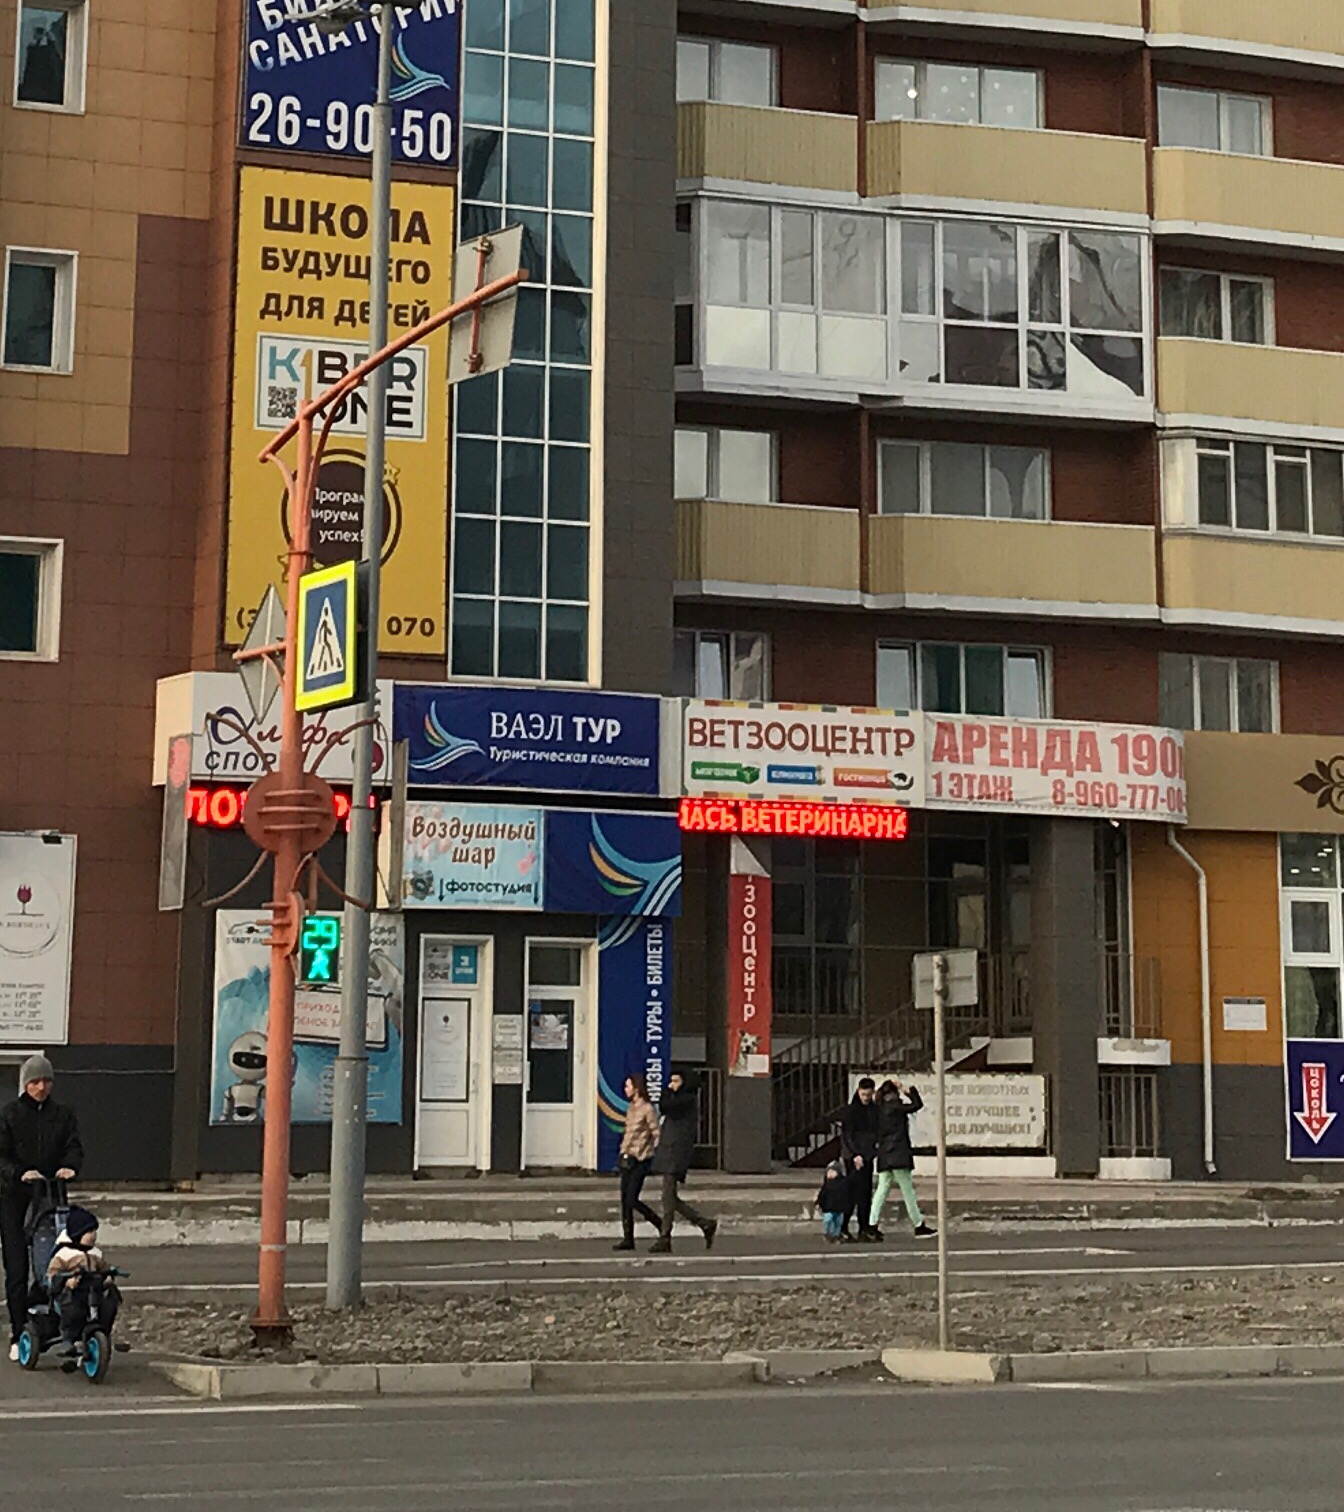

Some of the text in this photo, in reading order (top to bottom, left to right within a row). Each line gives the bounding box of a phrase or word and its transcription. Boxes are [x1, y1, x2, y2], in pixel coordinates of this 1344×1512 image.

[261, 246, 431, 286] БУДУЩГО
[259, 292, 431, 329] ДЛЯ ДЕЕЙ
[387, 616, 435, 638] 070
[490, 711, 622, 744] ВАЭЛ ТУР
[688, 717, 916, 757] ВЕТЗООЦЕНТР
[205, 750, 278, 772] СПОР
[489, 746, 650, 768] Туристическая компания
[932, 720, 1185, 781] АРЕНДА 190
[931, 771, 943, 798] 1
[948, 772, 1014, 803] ЭТАЖ
[412, 814, 536, 845] Воздушный
[452, 845, 496, 870] шар
[445, 878, 532, 895] фотостудия
[303, 919, 338, 950] 29
[646, 924, 663, 985] БИЛЕТЫ
[646, 1000, 663, 1042] ТУРЫ
[1309, 1068, 1321, 1130] ЦОКОЛЬ
